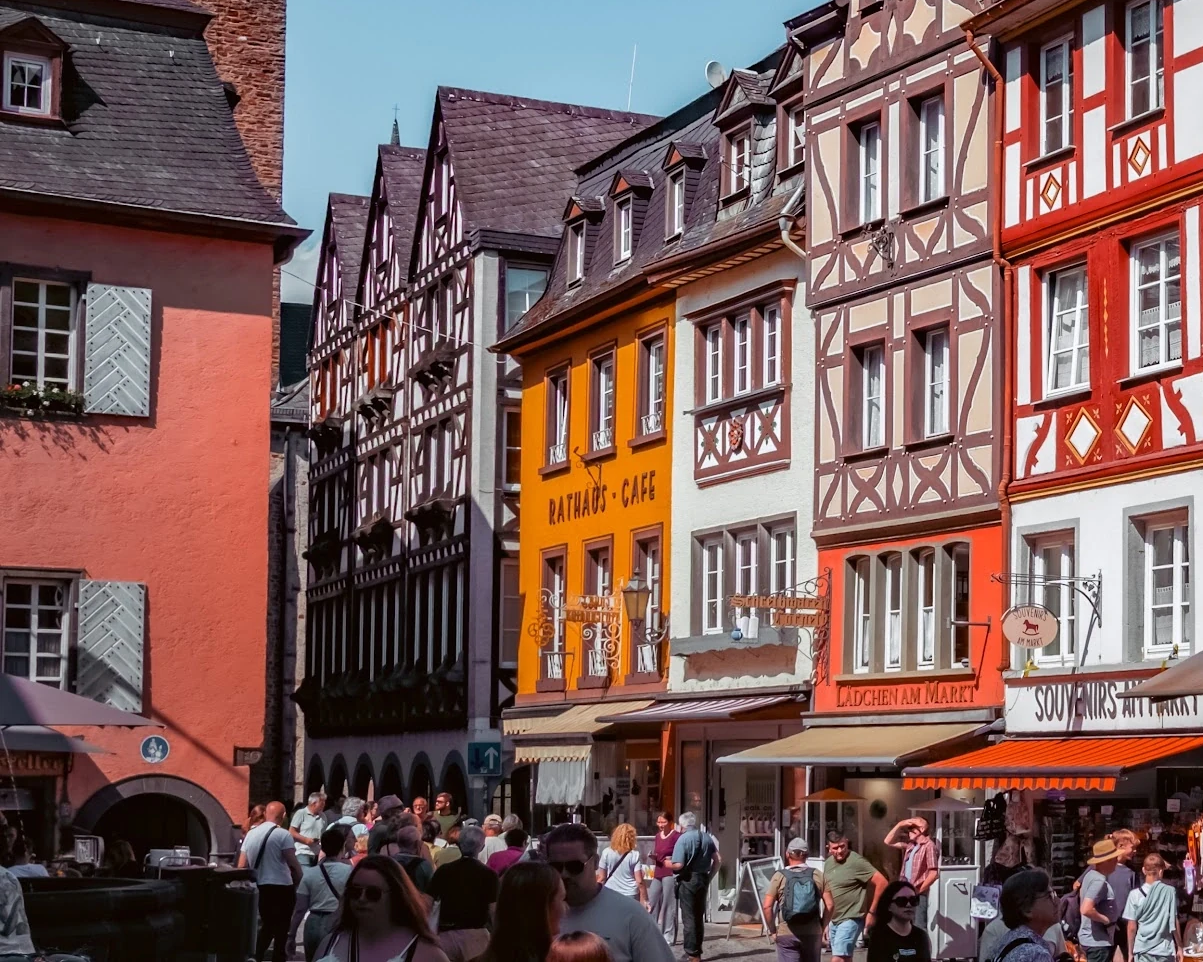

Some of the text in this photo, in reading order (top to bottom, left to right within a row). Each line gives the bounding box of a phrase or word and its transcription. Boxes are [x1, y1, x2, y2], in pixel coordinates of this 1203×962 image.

[549, 484, 608, 526] RATHAUS
[1013, 608, 1048, 622] SOUVENIRS
[1017, 637, 1044, 647] AM MARKT
[901, 687, 921, 705] AM
[924, 680, 976, 705] MARKT
